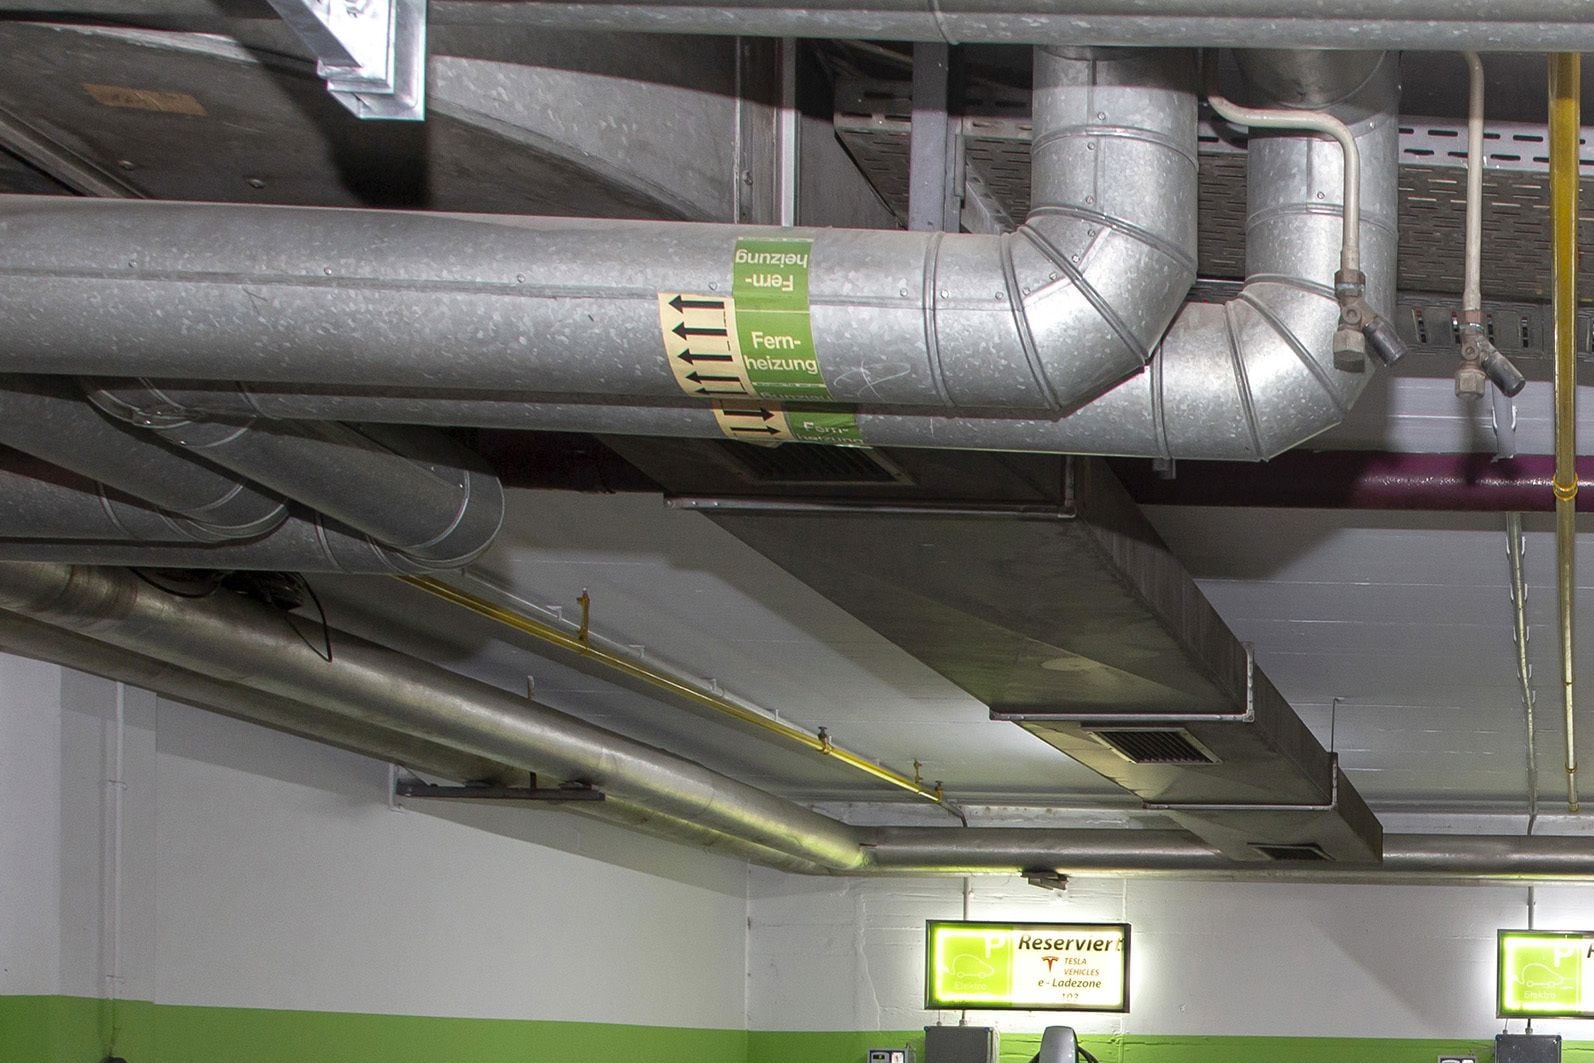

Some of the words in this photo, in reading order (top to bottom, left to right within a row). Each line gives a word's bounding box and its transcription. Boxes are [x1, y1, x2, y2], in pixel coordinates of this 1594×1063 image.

[735, 248, 809, 269] heizung
[745, 273, 794, 292] Fern-
[751, 331, 801, 350] Fern-
[745, 355, 819, 375] heizung
[1064, 957, 1087, 965] TESLA
[1064, 968, 1100, 976] VEHICLES
[1038, 979, 1044, 987] e
[1052, 978, 1102, 988] Ladezone
